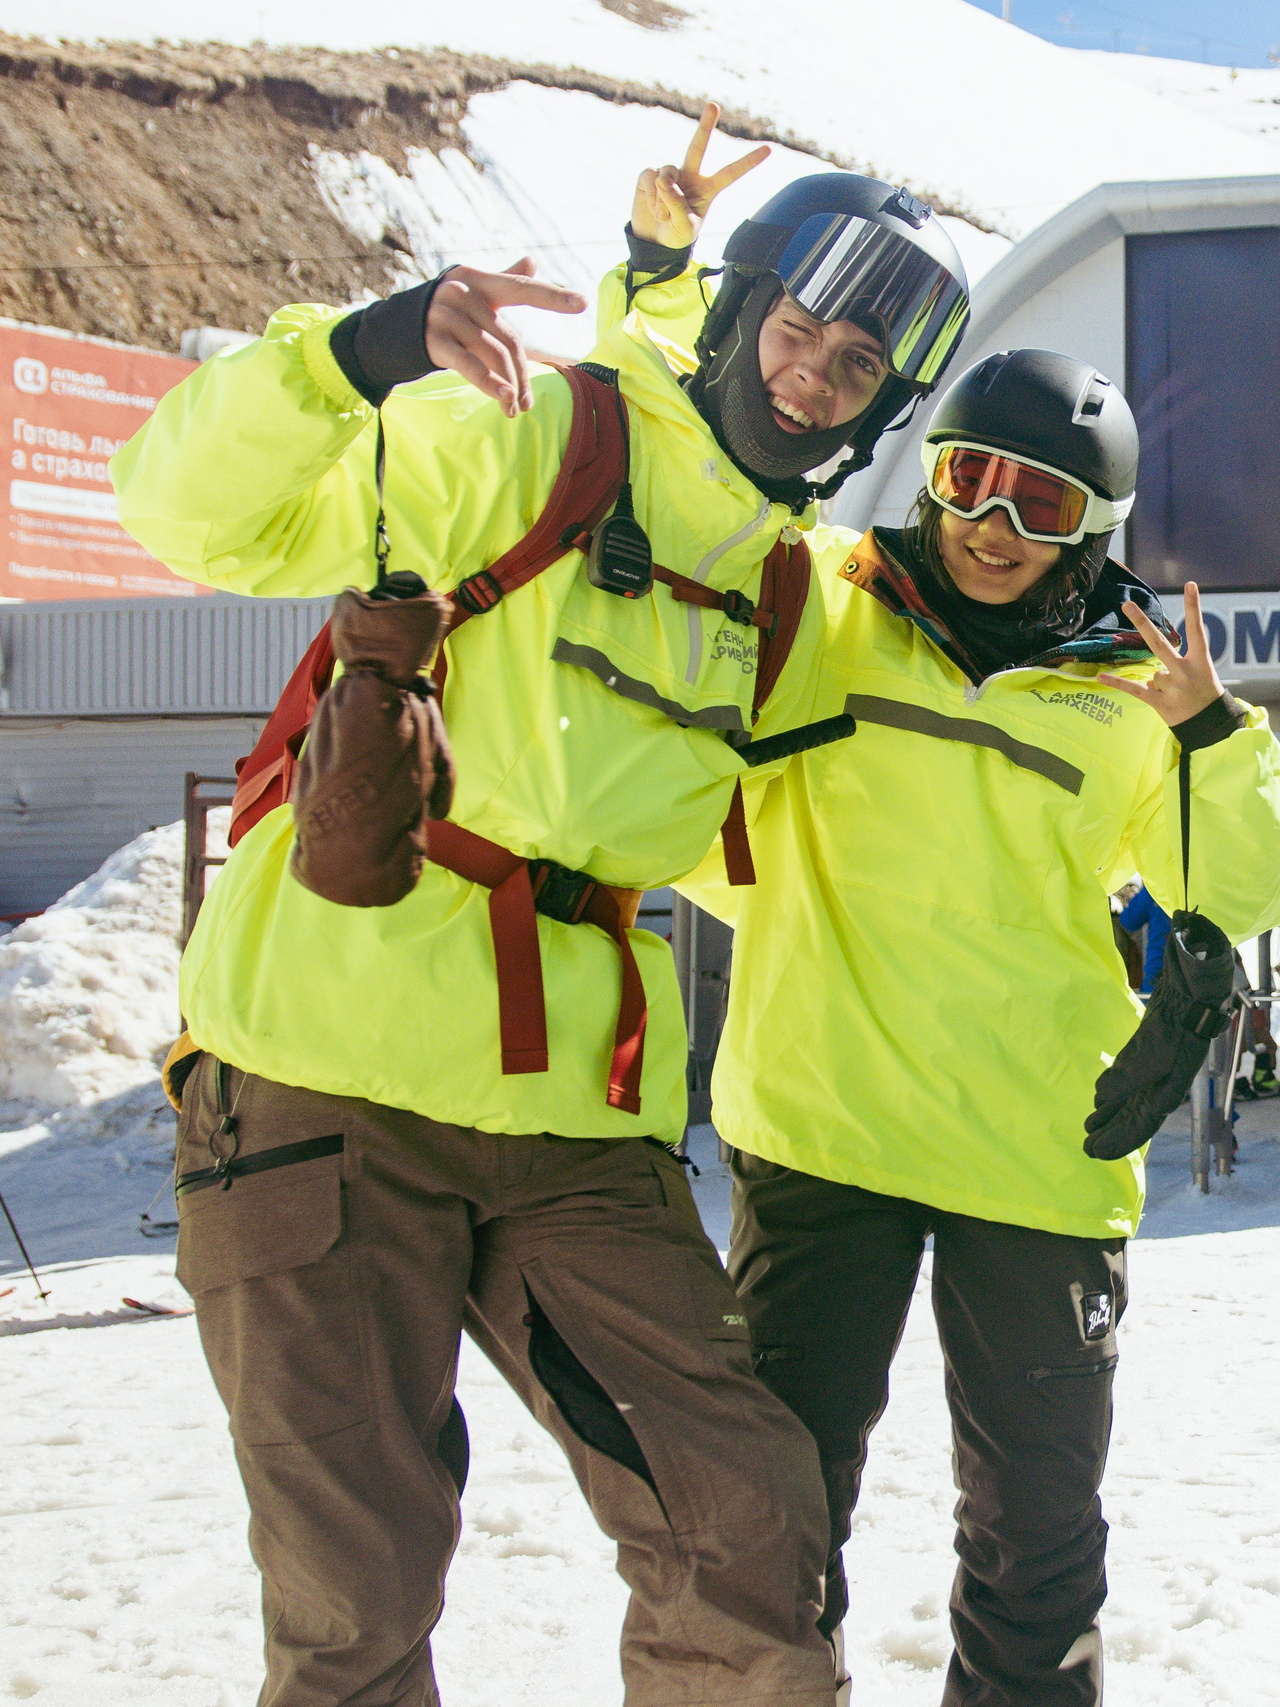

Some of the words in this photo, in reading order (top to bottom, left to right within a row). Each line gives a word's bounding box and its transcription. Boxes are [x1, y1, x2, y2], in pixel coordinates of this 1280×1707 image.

[51, 366, 107, 388] АЛЬФА
[50, 380, 157, 410] СТРАХОВАНИЕ
[12, 416, 86, 453] Готовь
[89, 435, 127, 457] лы
[11, 449, 26, 470] а
[31, 452, 111, 483] страхо
[1052, 692, 1123, 718] АДЕЛИНА
